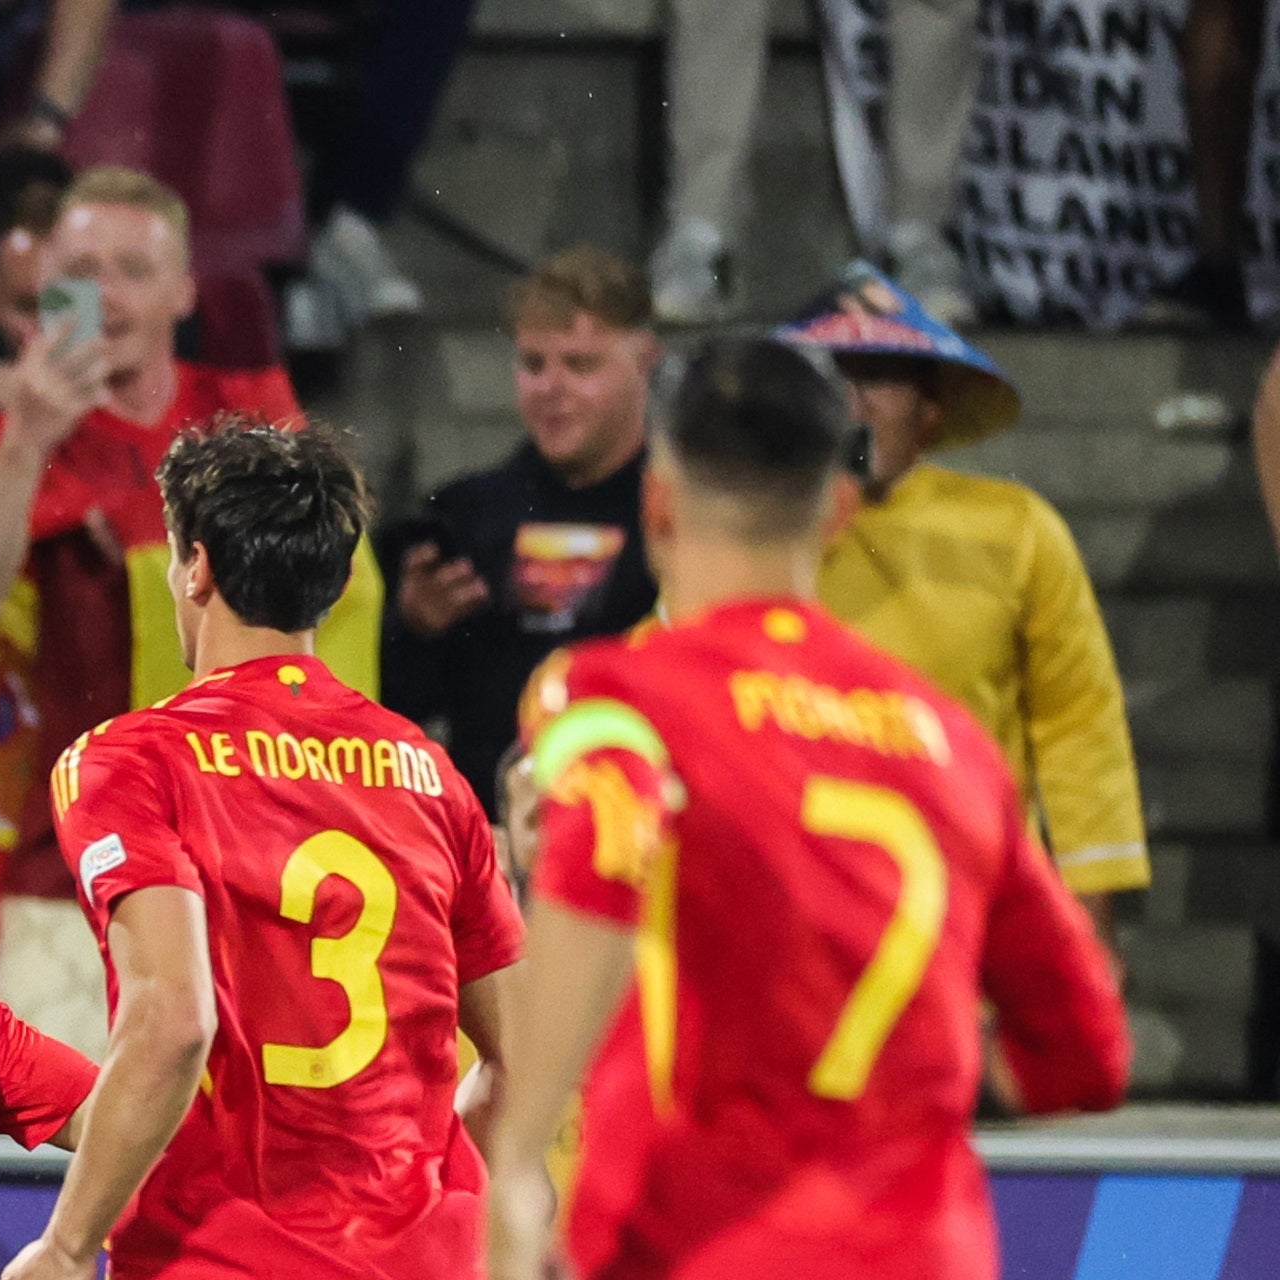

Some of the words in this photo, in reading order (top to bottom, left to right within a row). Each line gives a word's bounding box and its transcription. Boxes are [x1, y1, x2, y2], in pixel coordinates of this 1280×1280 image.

[185, 732, 241, 776] LE
[246, 730, 443, 797] NORMAND
[262, 829, 398, 1089] 3
[801, 775, 946, 1101] 7
